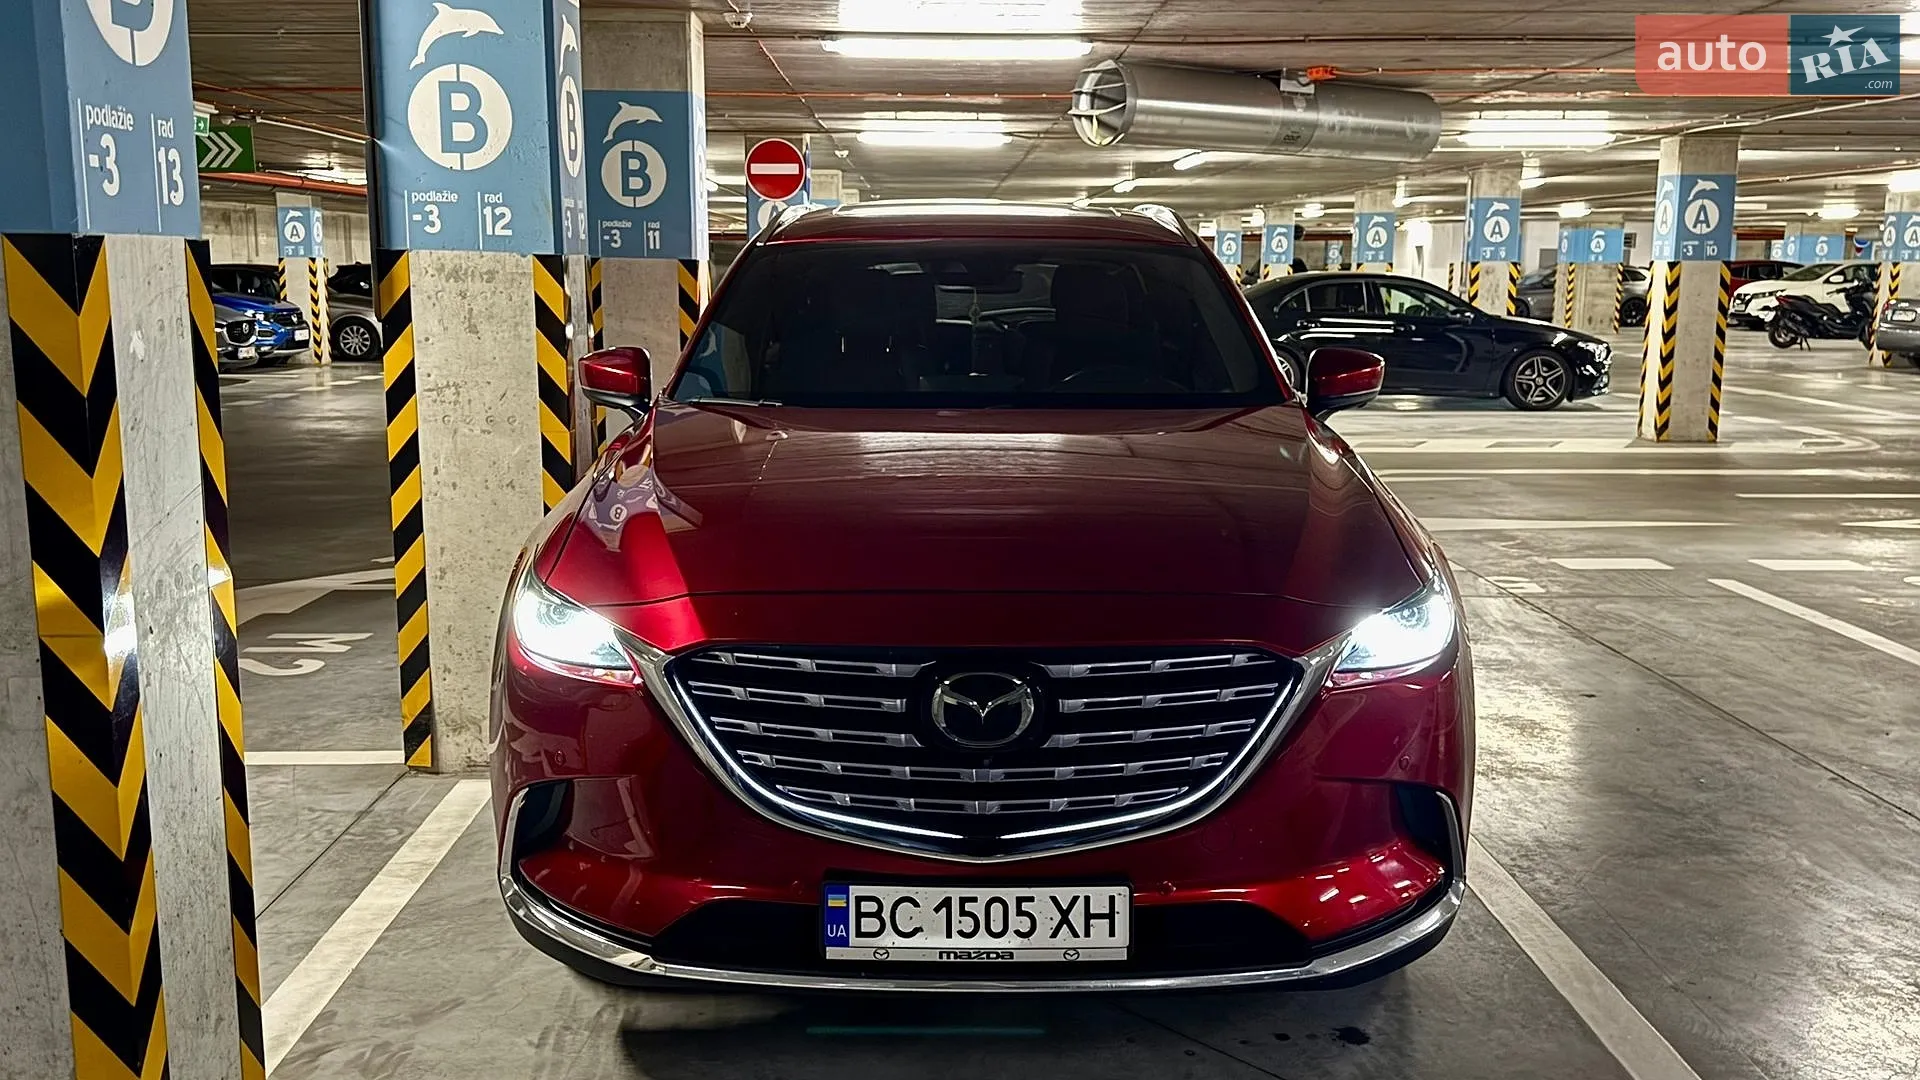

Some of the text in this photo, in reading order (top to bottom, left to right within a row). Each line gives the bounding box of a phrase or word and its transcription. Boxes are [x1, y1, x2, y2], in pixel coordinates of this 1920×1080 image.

[86, 104, 134, 132] podlažie
[157, 118, 174, 139] rad
[438, 81, 489, 155] B
[88, 133, 121, 198] -3
[157, 146, 185, 207] 13
[621, 150, 652, 197] B
[411, 190, 459, 206] podlažie
[484, 191, 503, 204] rad
[411, 205, 442, 235] -3
[482, 207, 513, 236] 12
[1692, 203, 1710, 230] A
[603, 229, 622, 248] -3
[647, 230, 661, 250] 11
[1706, 245, 1718, 257] 10
[854, 894, 1117, 940] BC 1505 XH
[827, 924, 847, 938] UA
